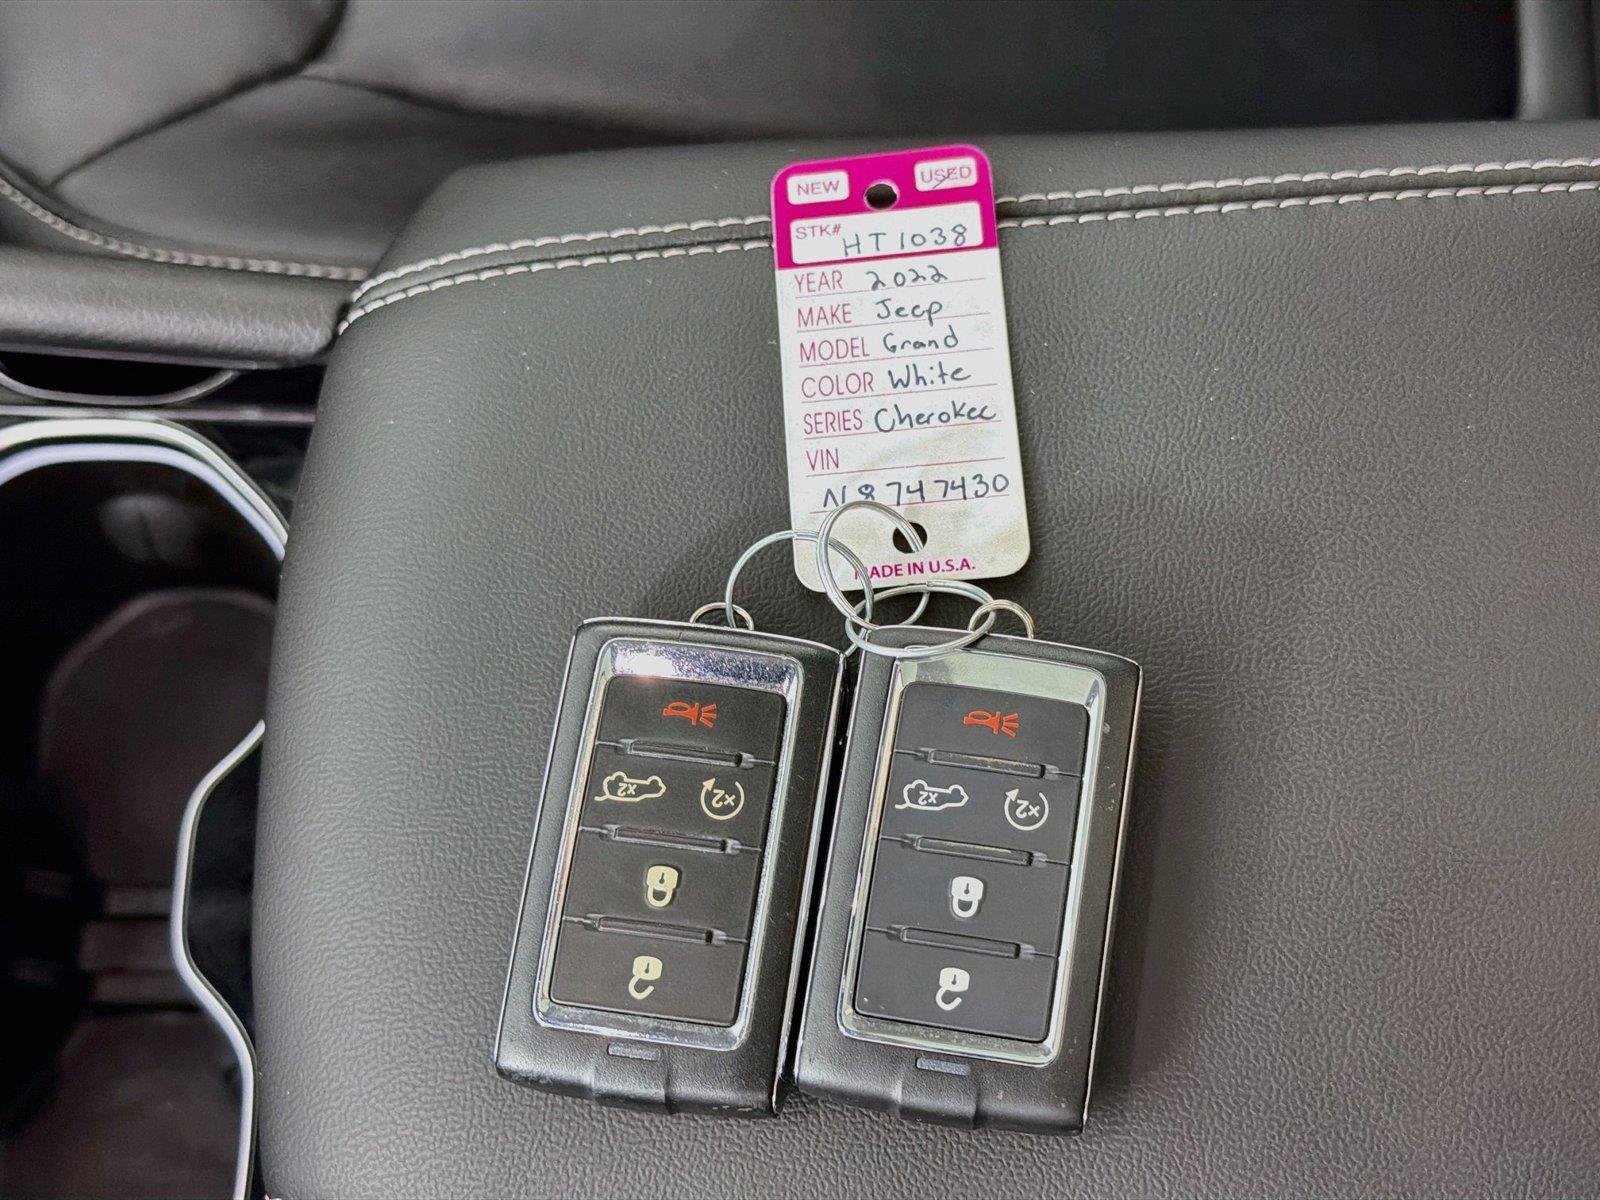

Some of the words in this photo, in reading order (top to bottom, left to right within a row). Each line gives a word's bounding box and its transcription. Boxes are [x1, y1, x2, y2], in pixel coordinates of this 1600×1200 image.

[796, 180, 840, 196] NEW
[920, 166, 972, 184] USED
[795, 223, 841, 240] STK#
[795, 270, 844, 294] YEAR
[865, 264, 948, 291] 2022
[797, 303, 852, 328] MAKE
[874, 298, 943, 326] Jeep
[799, 336, 870, 362] MODEL
[882, 324, 959, 353] Grand
[801, 371, 875, 398] COLOR
[887, 361, 972, 389] White
[803, 408, 863, 435] SERIES
[874, 400, 997, 433] Cherokee
[806, 448, 840, 471] VIN
[908, 561, 925, 576] IN
[929, 558, 976, 574] U.S.A.
